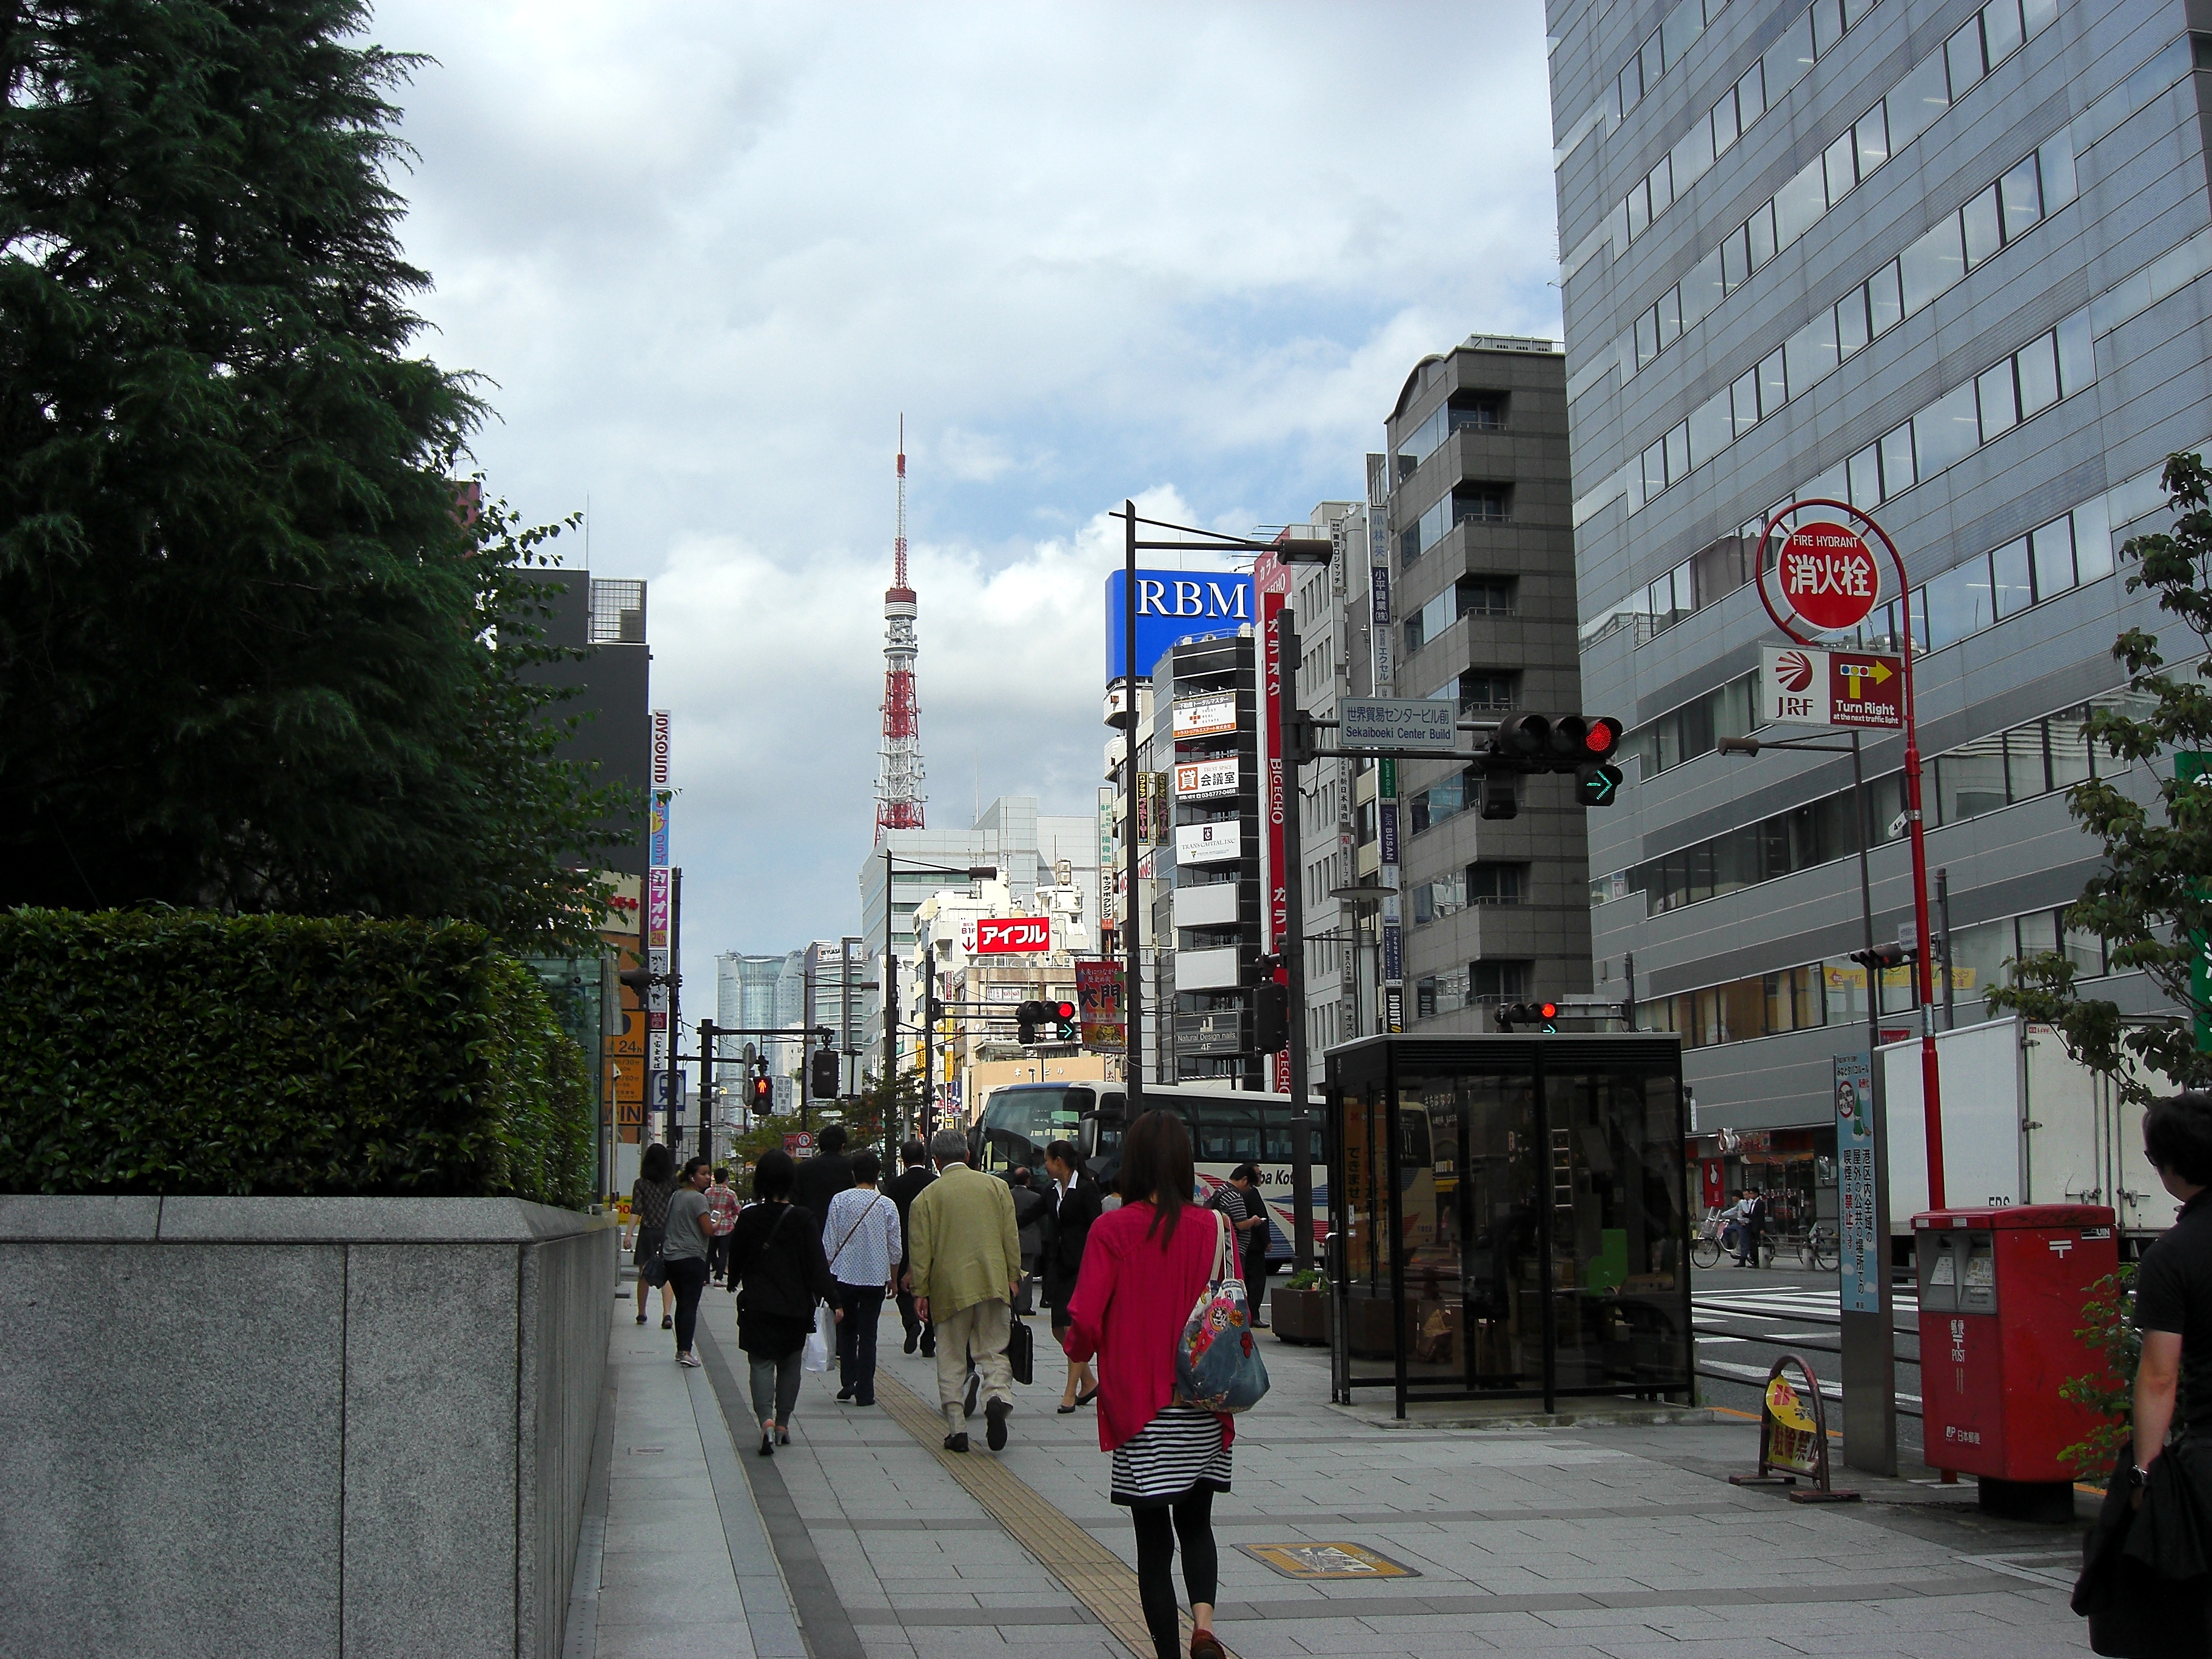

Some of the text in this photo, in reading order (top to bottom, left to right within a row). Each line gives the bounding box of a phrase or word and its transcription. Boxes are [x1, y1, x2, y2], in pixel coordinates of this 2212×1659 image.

[1793, 535, 1858, 548] FIRE HYDRANT
[1787, 554, 1871, 597] 消火栓
[1136, 580, 1248, 618] RBM
[1379, 647, 1389, 681] エクセル
[1347, 706, 1449, 725] 世界貿易センタービル前
[1776, 696, 1814, 719] JRF
[1836, 699, 1895, 716] Turn Right
[1865, 714, 1884, 723] traffic
[1885, 716, 1899, 725] light
[1346, 726, 1450, 740] Sekaiboeki Center Build
[654, 712, 668, 783] JOYSOUND
[1180, 769, 1196, 789] 貸
[1201, 771, 1235, 787] 会議室
[1269, 758, 1282, 785] BIG
[1272, 786, 1283, 824] ECHO
[1103, 875, 1111, 918] キックボクシング
[652, 933, 666, 944] 24h
[981, 925, 1047, 945] アイフル
[1079, 983, 1122, 1008] 大門
[618, 1040, 642, 1053] 24h
[1178, 1033, 1198, 1042] Natural
[1200, 1033, 1220, 1041] Design
[1201, 1042, 1212, 1051] 4F
[1862, 1148, 1872, 1243] 港区内全域の
[1853, 1148, 1865, 1295] 屋外の公共の場所での
[1951, 1319, 1965, 1335] 郵便
[1952, 1349, 1965, 1362] POST
[1957, 1429, 1981, 1445] 日本郵便
